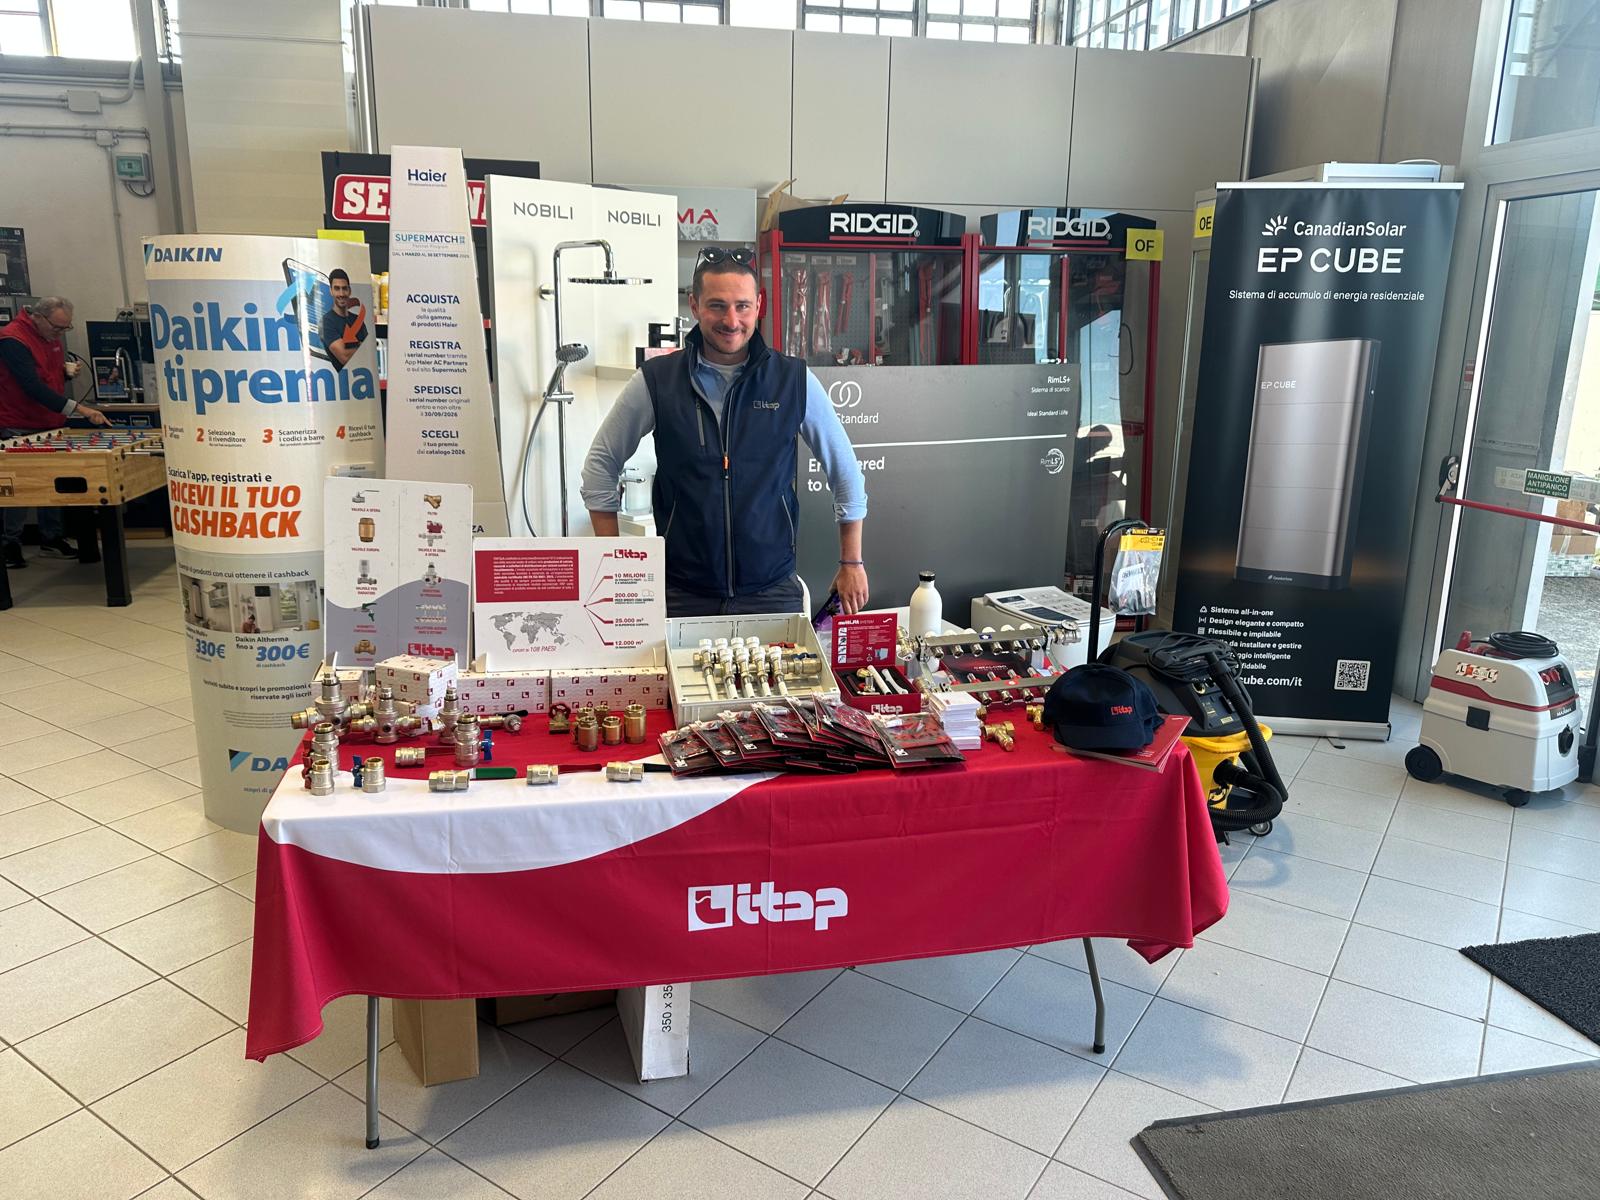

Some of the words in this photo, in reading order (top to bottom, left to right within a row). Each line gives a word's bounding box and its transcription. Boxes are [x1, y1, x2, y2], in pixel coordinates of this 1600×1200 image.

[408, 169, 447, 182] Haier
[513, 202, 573, 219] NOBILI
[607, 210, 661, 227] NOBILI
[829, 212, 918, 234] RIDGID
[1199, 217, 1212, 230] OE
[1027, 216, 1110, 238] RIDGID
[1293, 221, 1407, 237] CanadianSolar
[395, 234, 458, 243] SUPERMATCH
[1134, 239, 1155, 252] OF
[154, 247, 223, 263] DAIKIN
[1257, 247, 1303, 273] EP
[1309, 248, 1404, 274] CUBE
[406, 294, 460, 305] ACQUISTA
[1229, 290, 1265, 299] Sistema
[1267, 290, 1276, 299] di
[1278, 290, 1322, 300] accumulo
[1323, 290, 1332, 300] di
[1333, 292, 1368, 302] energia
[1370, 290, 1425, 301] residenziale
[150, 301, 302, 352] Daikin
[410, 340, 461, 350] REGISTRA
[163, 354, 189, 402] ti
[1047, 376, 1071, 384] RimLS+
[1261, 381, 1273, 389] EP
[1273, 380, 1296, 389] CUBE
[414, 385, 462, 395] SPEDISCI
[762, 402, 780, 410] itap
[837, 413, 879, 423] Standard
[196, 427, 205, 443] 2
[262, 428, 273, 443] 3
[282, 435, 303, 443] codici
[336, 425, 345, 440] 4
[421, 430, 459, 439] SCEGLI
[168, 466, 187, 478] Scarica
[187, 469, 210, 483] l'app,
[211, 472, 262, 485] registrati
[1527, 471, 1570, 485] MANIGLIONE
[808, 479, 822, 492] to
[1527, 479, 1568, 492] ANTIPANICO
[170, 480, 215, 505] RICEVI
[220, 486, 239, 508] IL
[246, 485, 302, 508] TUO
[173, 508, 302, 539] CASHBACK
[624, 549, 648, 560] itap
[235, 571, 266, 579] ottenere
[273, 570, 309, 578] cashback
[1210, 606, 1240, 615] Sistema
[1209, 617, 1234, 626] Design
[1208, 628, 1242, 637] Flessibile
[196, 638, 226, 659] 330€
[256, 643, 310, 661] 300€
[421, 643, 455, 660] itap
[1239, 641, 1271, 649] installare
[1277, 642, 1302, 650] gestire
[1253, 652, 1291, 660] intelligente
[1239, 675, 1303, 687] cube.com/it
[266, 684, 307, 692] promozioni
[281, 692, 295, 700] agli
[880, 704, 903, 716] itap
[1118, 705, 1133, 715] itap
[251, 758, 288, 771] DA
[736, 881, 849, 931] itap
[664, 1001, 673, 1009] x
[661, 1011, 672, 1033] 350
